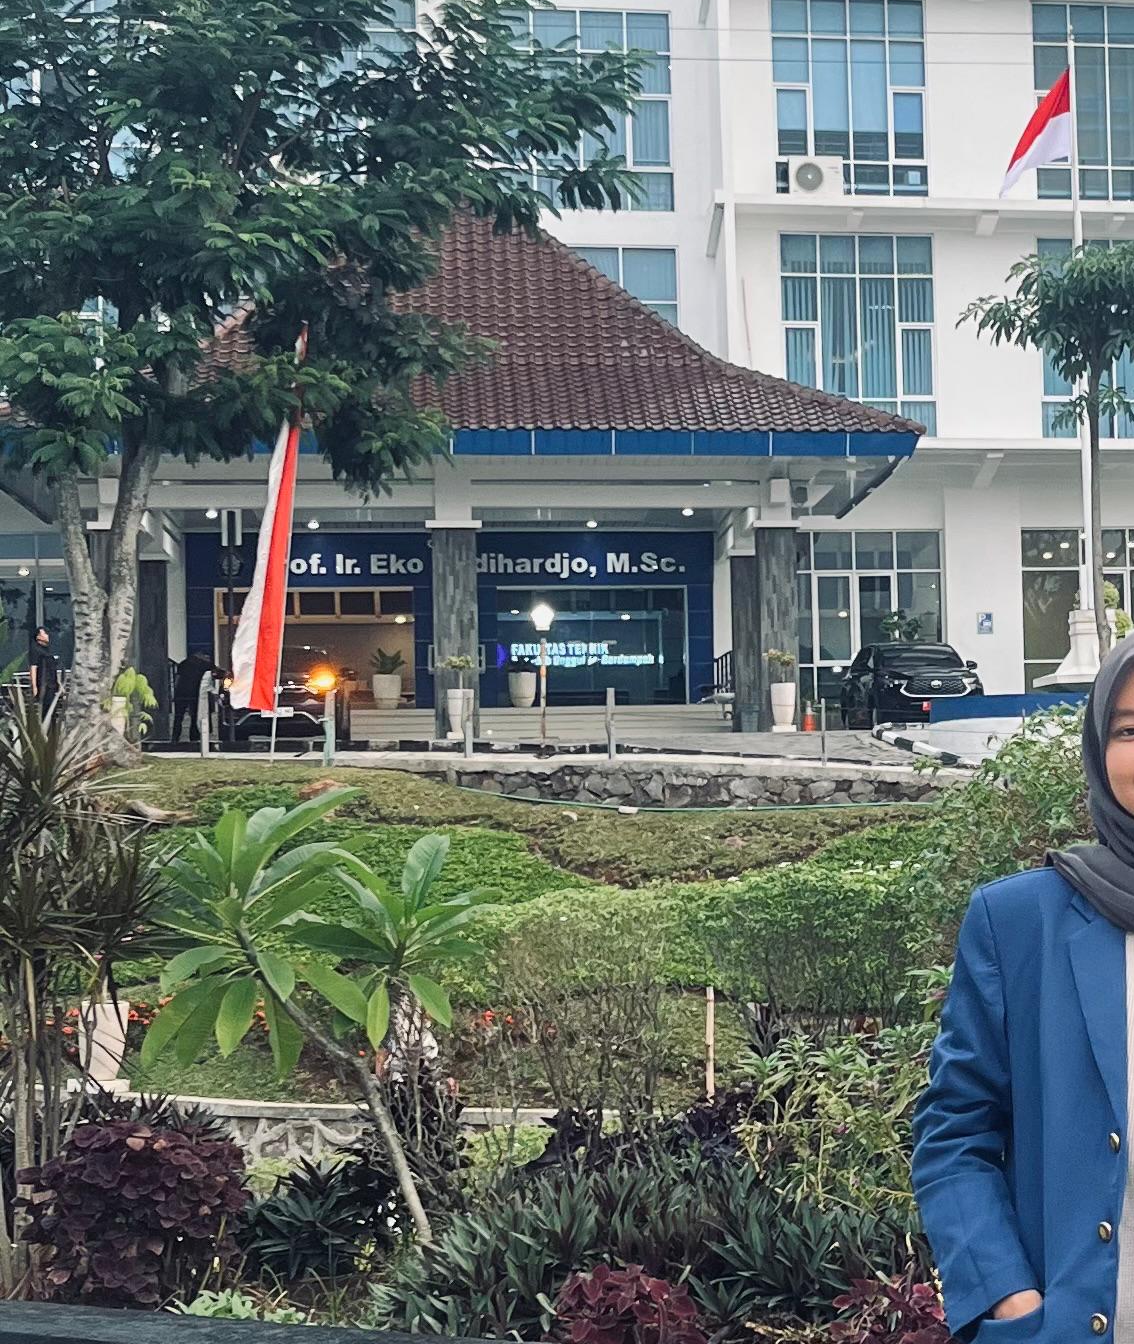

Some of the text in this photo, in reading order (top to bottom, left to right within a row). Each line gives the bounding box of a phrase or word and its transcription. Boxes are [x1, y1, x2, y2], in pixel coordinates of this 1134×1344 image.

[335, 553, 361, 575] Ir.
[370, 553, 424, 575] Eko
[475, 552, 597, 579] dihardjo,
[606, 552, 686, 574] M.Sc.
